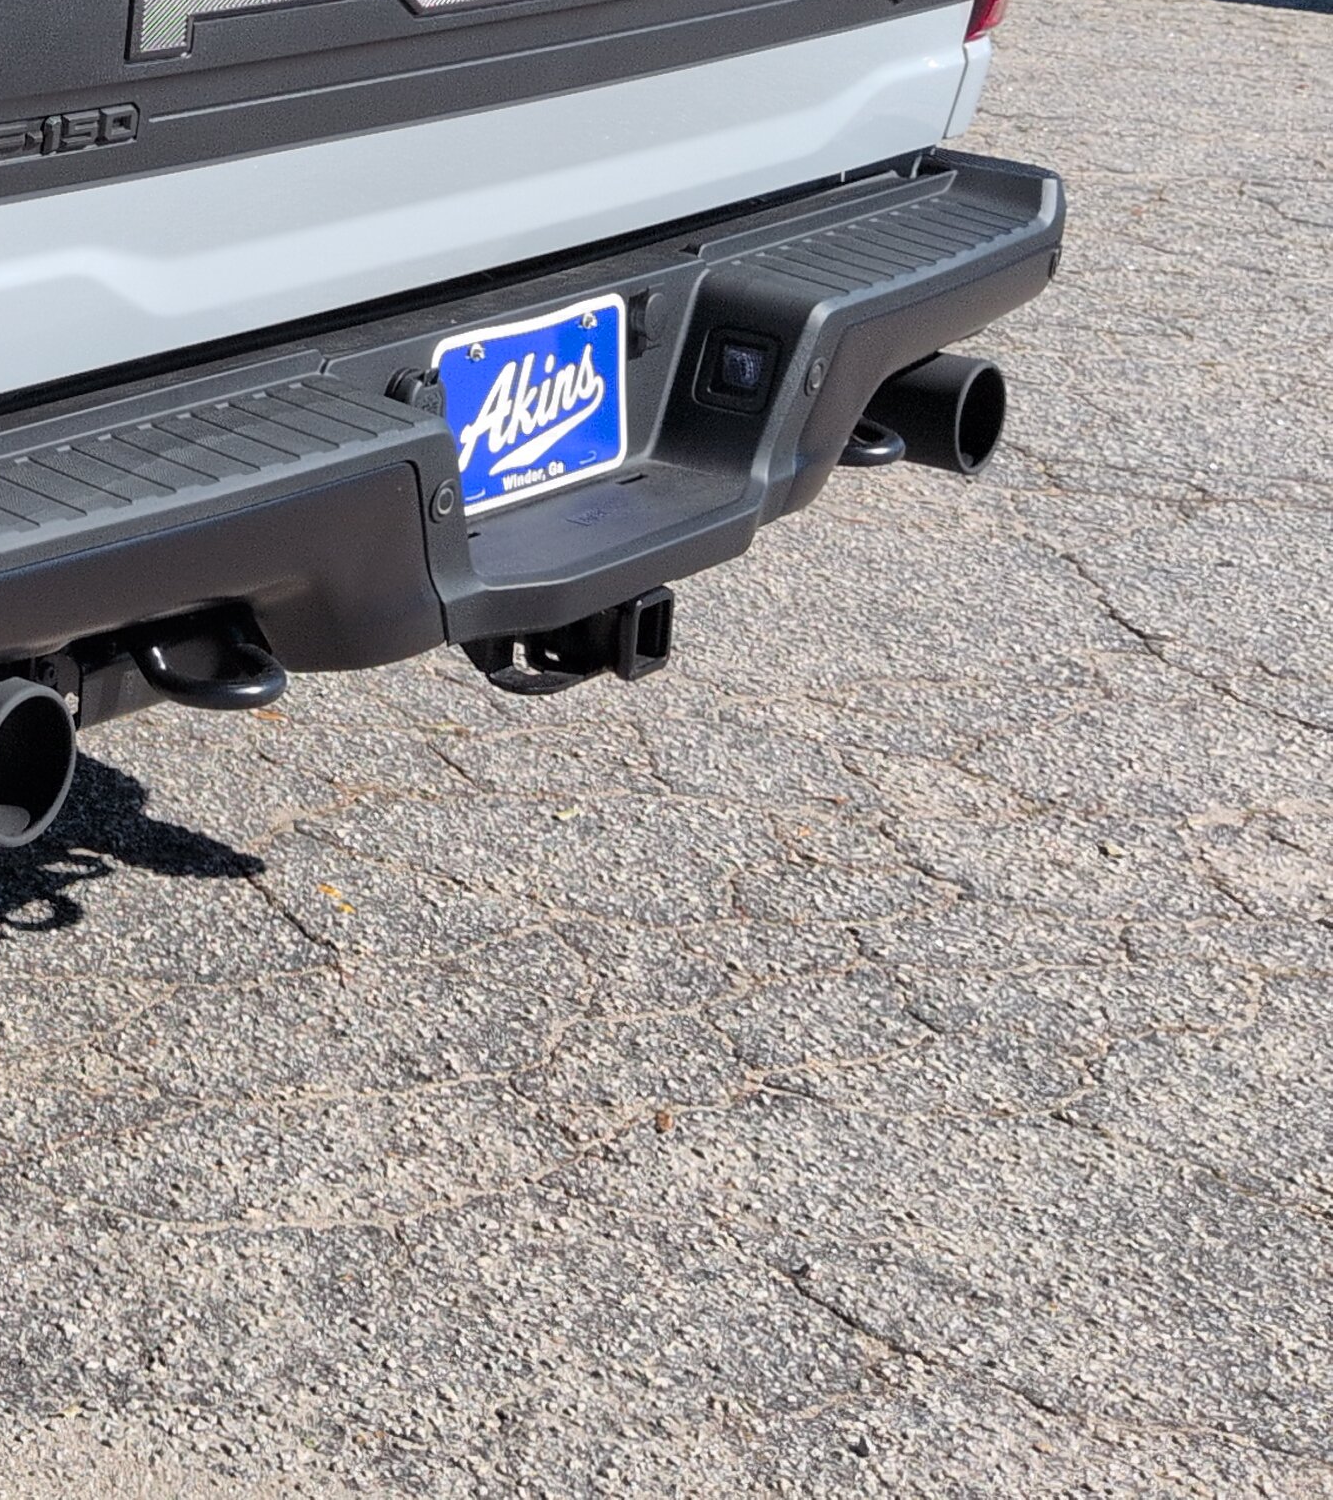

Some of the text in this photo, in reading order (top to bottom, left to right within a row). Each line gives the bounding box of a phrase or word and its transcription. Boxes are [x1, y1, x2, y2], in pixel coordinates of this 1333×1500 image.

[459, 344, 604, 474] Akins
[502, 461, 564, 491] Winder, Ga
